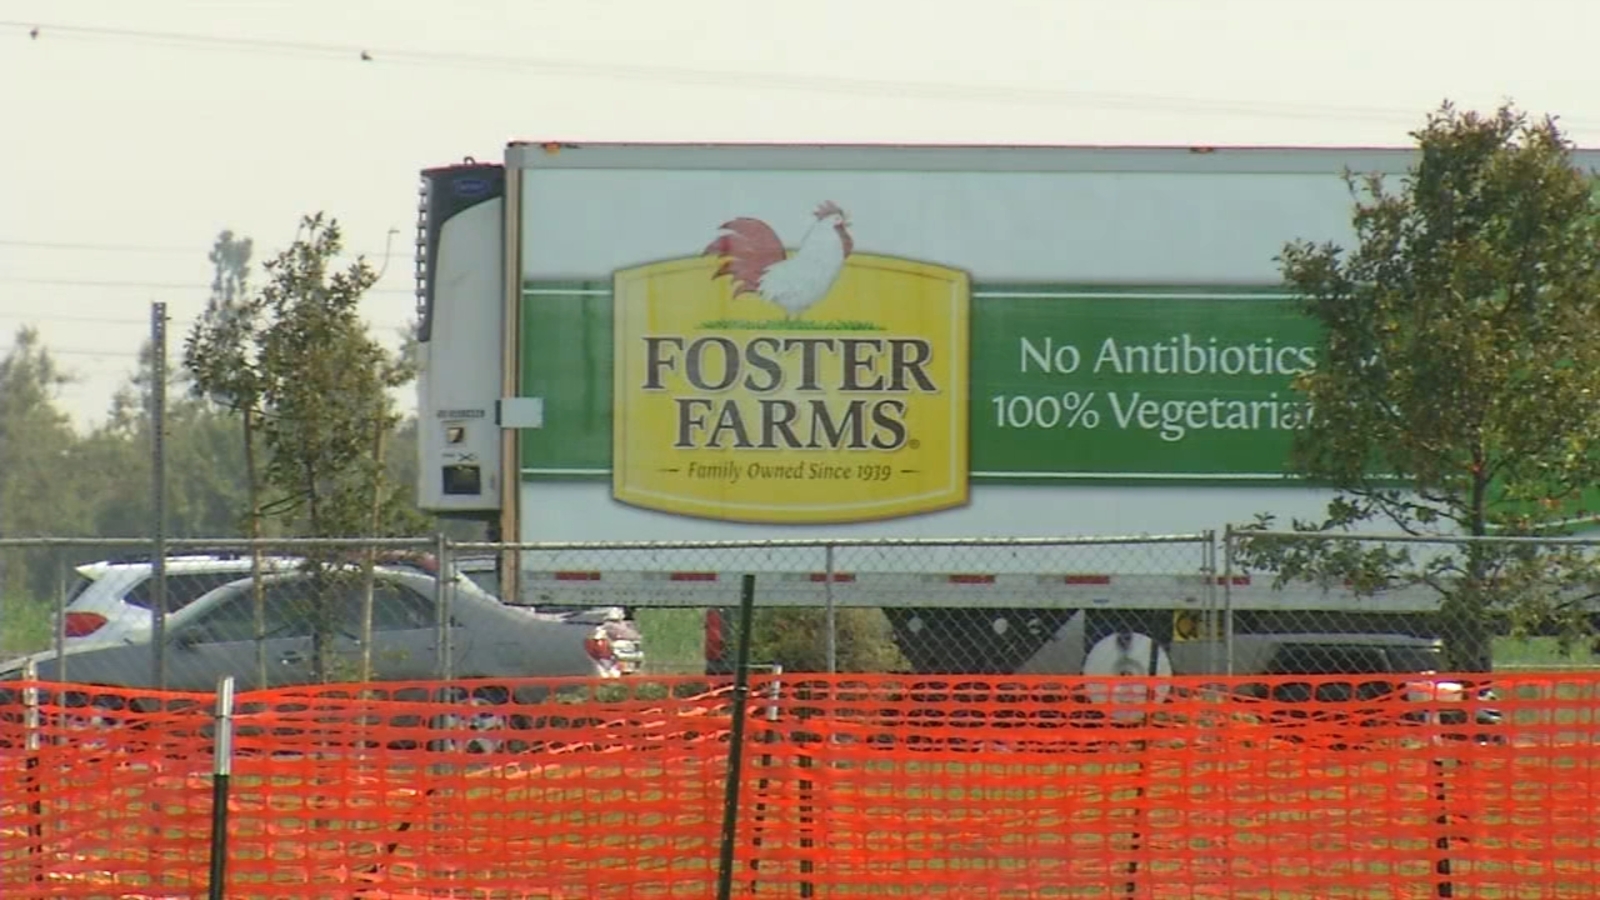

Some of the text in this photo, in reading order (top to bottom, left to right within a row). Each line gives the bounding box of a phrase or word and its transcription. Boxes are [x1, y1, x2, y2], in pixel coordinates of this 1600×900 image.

[641, 336, 938, 392] FOSTER
[1019, 333, 1317, 375] No Antibiotics
[673, 398, 907, 450] FARMS
[991, 391, 1100, 430] 100%
[688, 461, 892, 484] Family Owned Since 1939
